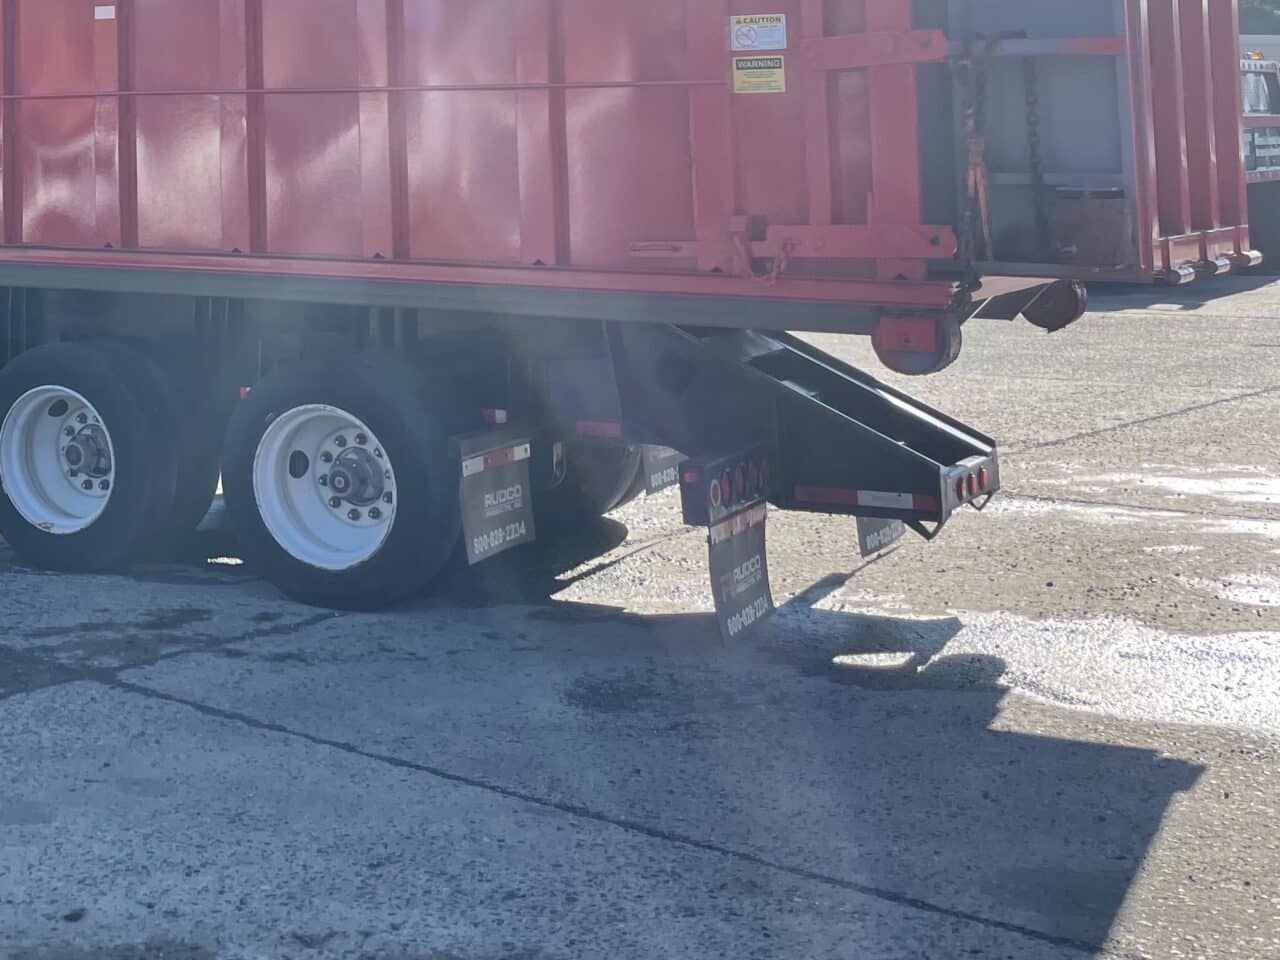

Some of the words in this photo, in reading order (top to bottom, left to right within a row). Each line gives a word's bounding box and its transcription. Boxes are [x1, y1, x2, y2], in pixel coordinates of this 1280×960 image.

[743, 16, 782, 25] CAUTION
[736, 59, 781, 69] WARNING
[484, 485, 522, 507] RUDCO
[733, 554, 761, 581] RUDCO
